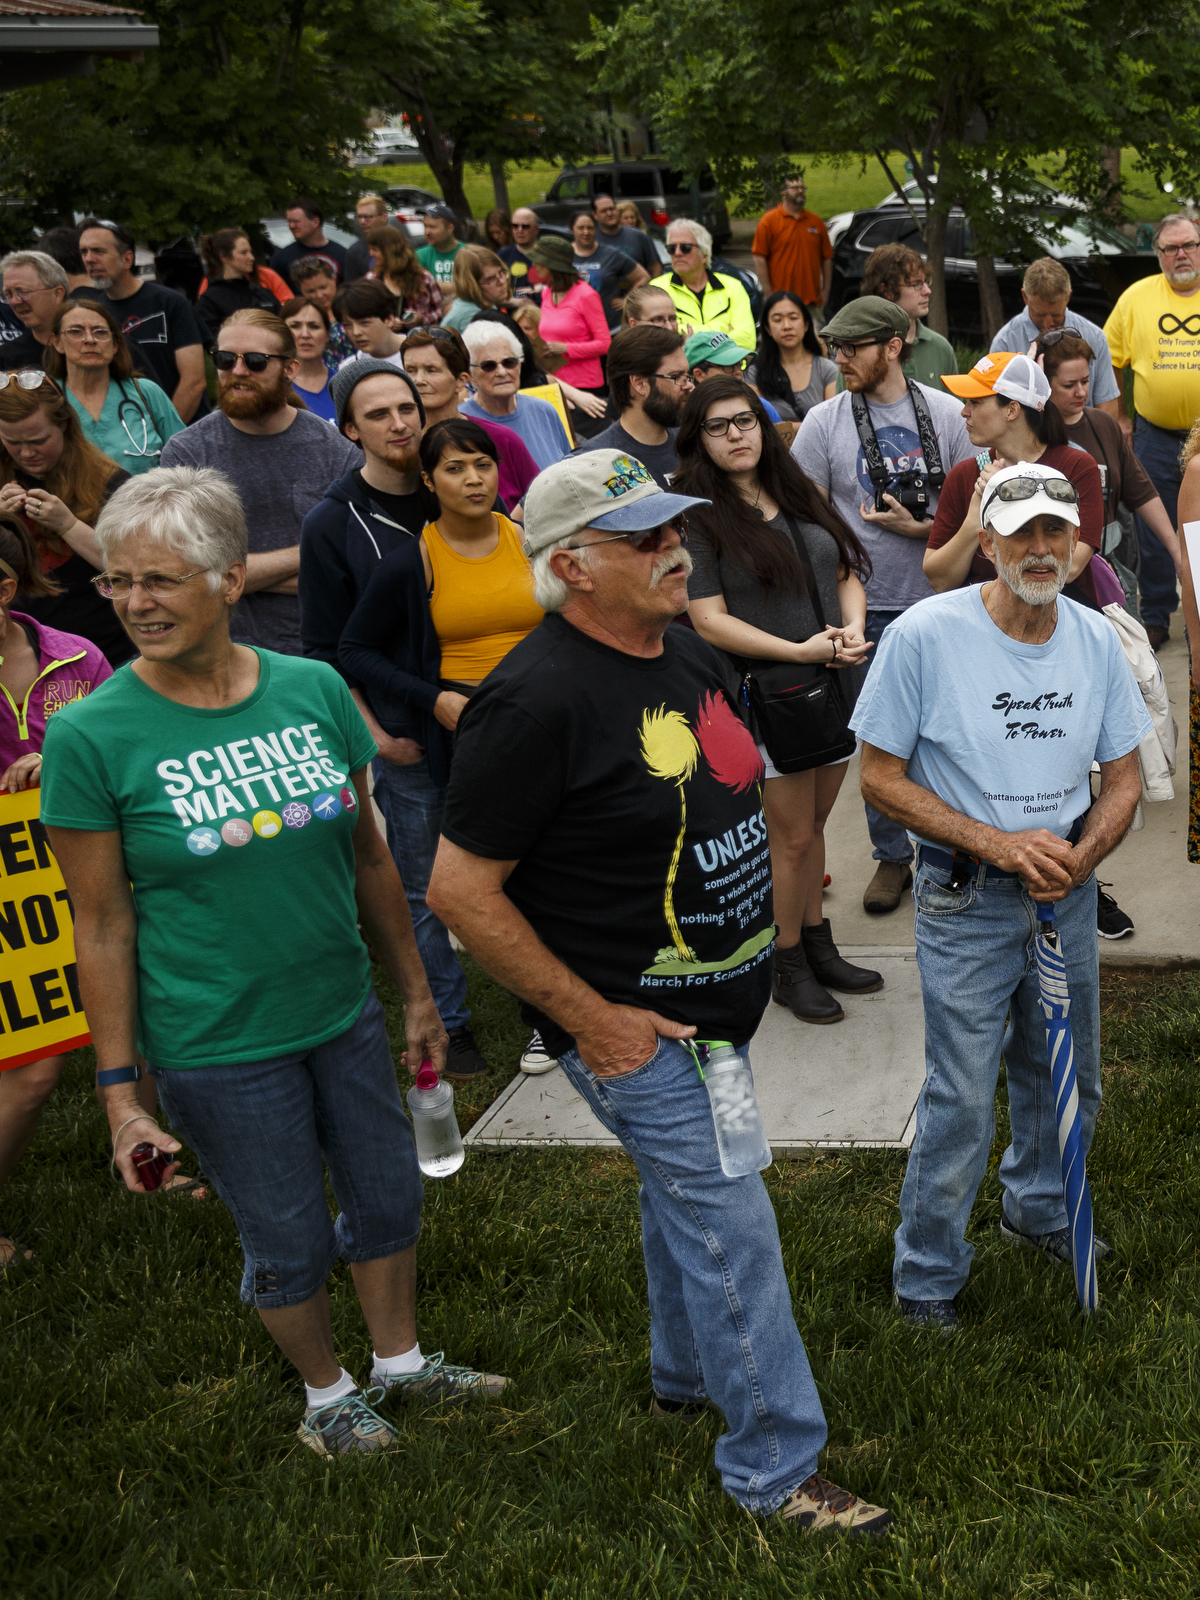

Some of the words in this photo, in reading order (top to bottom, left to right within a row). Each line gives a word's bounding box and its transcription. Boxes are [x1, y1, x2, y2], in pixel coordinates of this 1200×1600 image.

[1158, 337, 1174, 347] Only
[1175, 338, 1200, 347] Trump's
[1158, 350, 1191, 359] Ignorance
[1192, 350, 1200, 358] Of
[1152, 362, 1178, 371] Science
[1179, 362, 1186, 370] Is
[861, 456, 928, 475] NASA
[44, 680, 91, 702] RUN
[991, 691, 1043, 717] Speak
[1042, 691, 1073, 711] Truth
[1005, 722, 1022, 740] To
[1020, 722, 1067, 740] Power.
[156, 723, 330, 797] SCIENCE
[171, 757, 347, 827] MATTERS
[982, 791, 1035, 803] Chattanooga
[1037, 789, 1062, 802] Friends
[1023, 802, 1058, 814] (Quakers)
[693, 809, 767, 873] UNLESS
[704, 869, 741, 890] someone
[740, 862, 751, 875] like
[750, 854, 761, 869] you
[719, 895, 726, 904] a
[727, 883, 746, 900] whole
[746, 869, 762, 889] awful
[680, 911, 725, 926] nothing
[727, 907, 735, 917] is
[736, 895, 753, 918] going
[753, 891, 760, 901] to
[740, 913, 750, 930] It's
[750, 905, 762, 919] not.
[640, 975, 682, 988] March
[686, 974, 710, 986] For
[713, 962, 751, 983] Science
